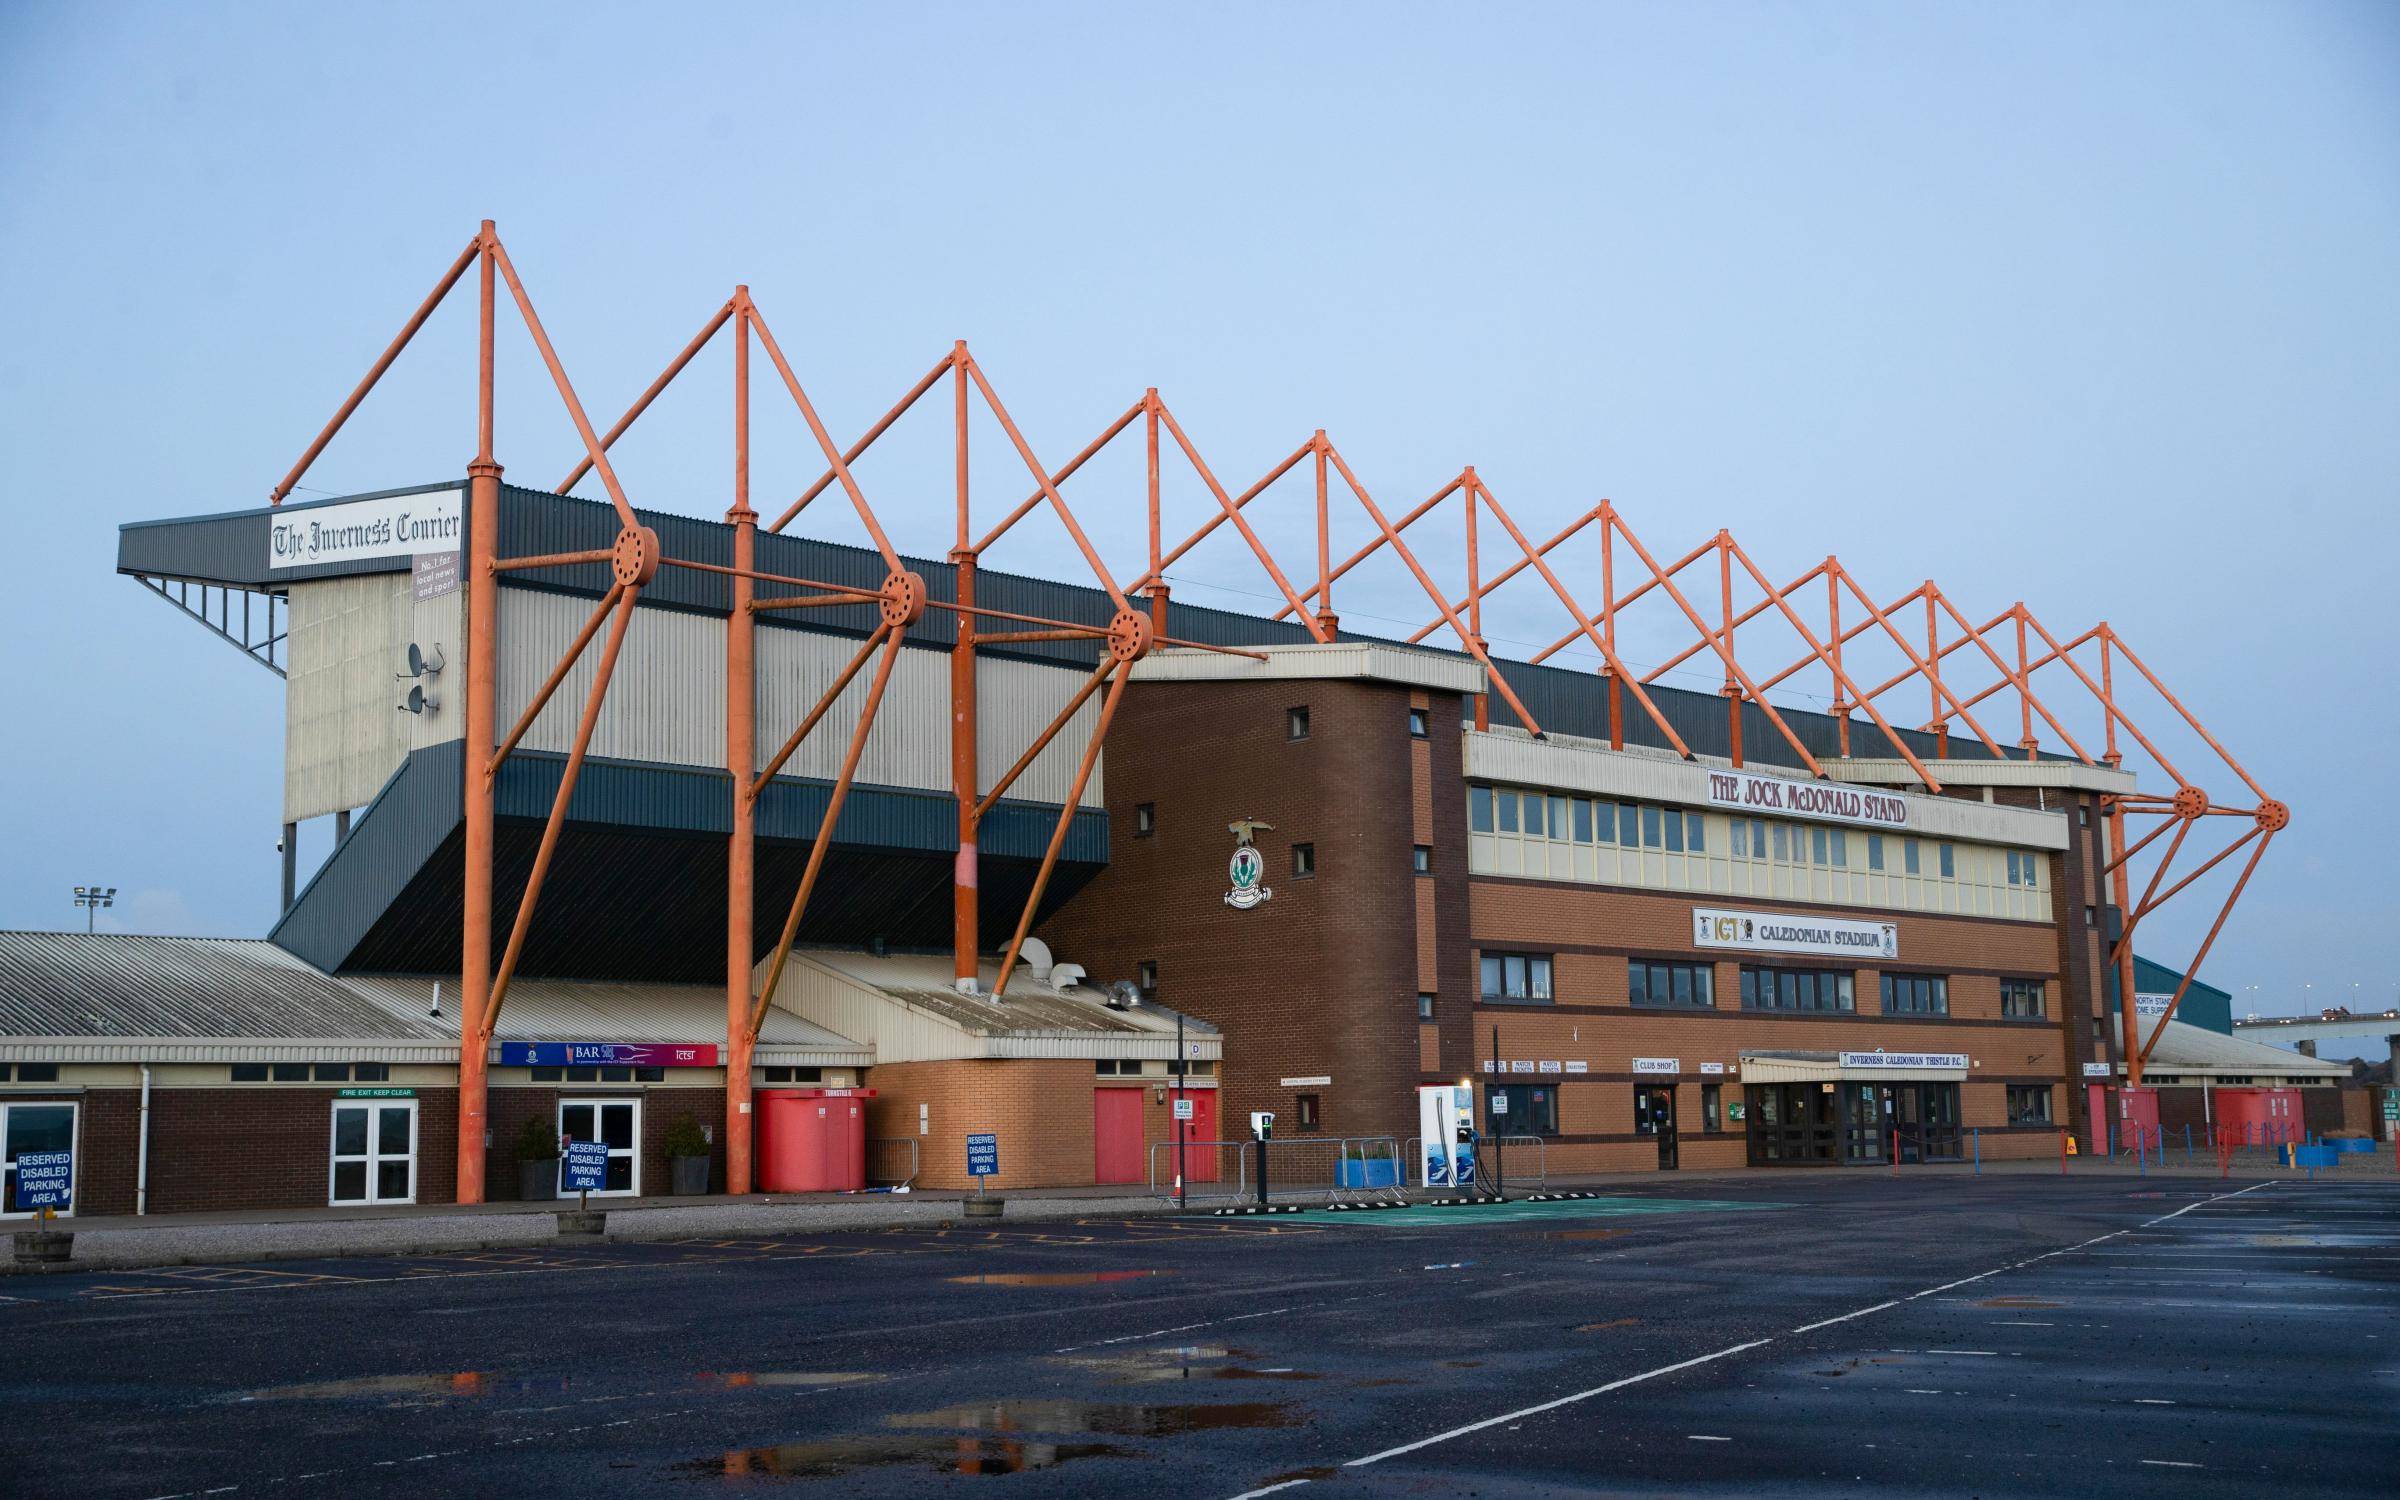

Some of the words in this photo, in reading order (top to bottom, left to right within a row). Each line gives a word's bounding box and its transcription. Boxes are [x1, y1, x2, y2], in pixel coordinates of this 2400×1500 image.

[272, 523, 304, 561] The
[308, 517, 391, 560] Inverness
[396, 506, 460, 544] Courier
[416, 571, 434, 586] local
[435, 567, 455, 580] news
[418, 583, 433, 597] and
[434, 578, 454, 594] sport
[1710, 774, 1739, 803] THE
[1744, 779, 1783, 808] JOCK
[1787, 784, 1861, 818] McDONALD
[1864, 794, 1907, 823] STAND
[1714, 916, 1739, 942] ICT
[1759, 925, 1832, 945] CALEDONIAN
[1835, 931, 1880, 948] STADIUM
[575, 1046, 600, 1058] BAR
[1640, 1062, 1656, 1070] CLUB
[1657, 1062, 1673, 1070] SHOP
[1849, 1055, 1884, 1065] INVERNESS
[1885, 1055, 1924, 1066] CALEDONIAN
[1926, 1056, 1950, 1066] THISTLE
[968, 1135, 995, 1145] RESERVED
[570, 1143, 607, 1154] RESERVED
[969, 1145, 995, 1154] DISABLED
[19, 1153, 71, 1166] RESERVED
[570, 1154, 605, 1165] DISABLED
[971, 1155, 994, 1164] PARKING
[21, 1166, 69, 1179] DISABLED
[571, 1165, 602, 1176] PARKING
[976, 1165, 991, 1173] AREA
[24, 1179, 66, 1192] PARKING
[576, 1177, 596, 1187] AREA
[32, 1193, 57, 1204] AREA
